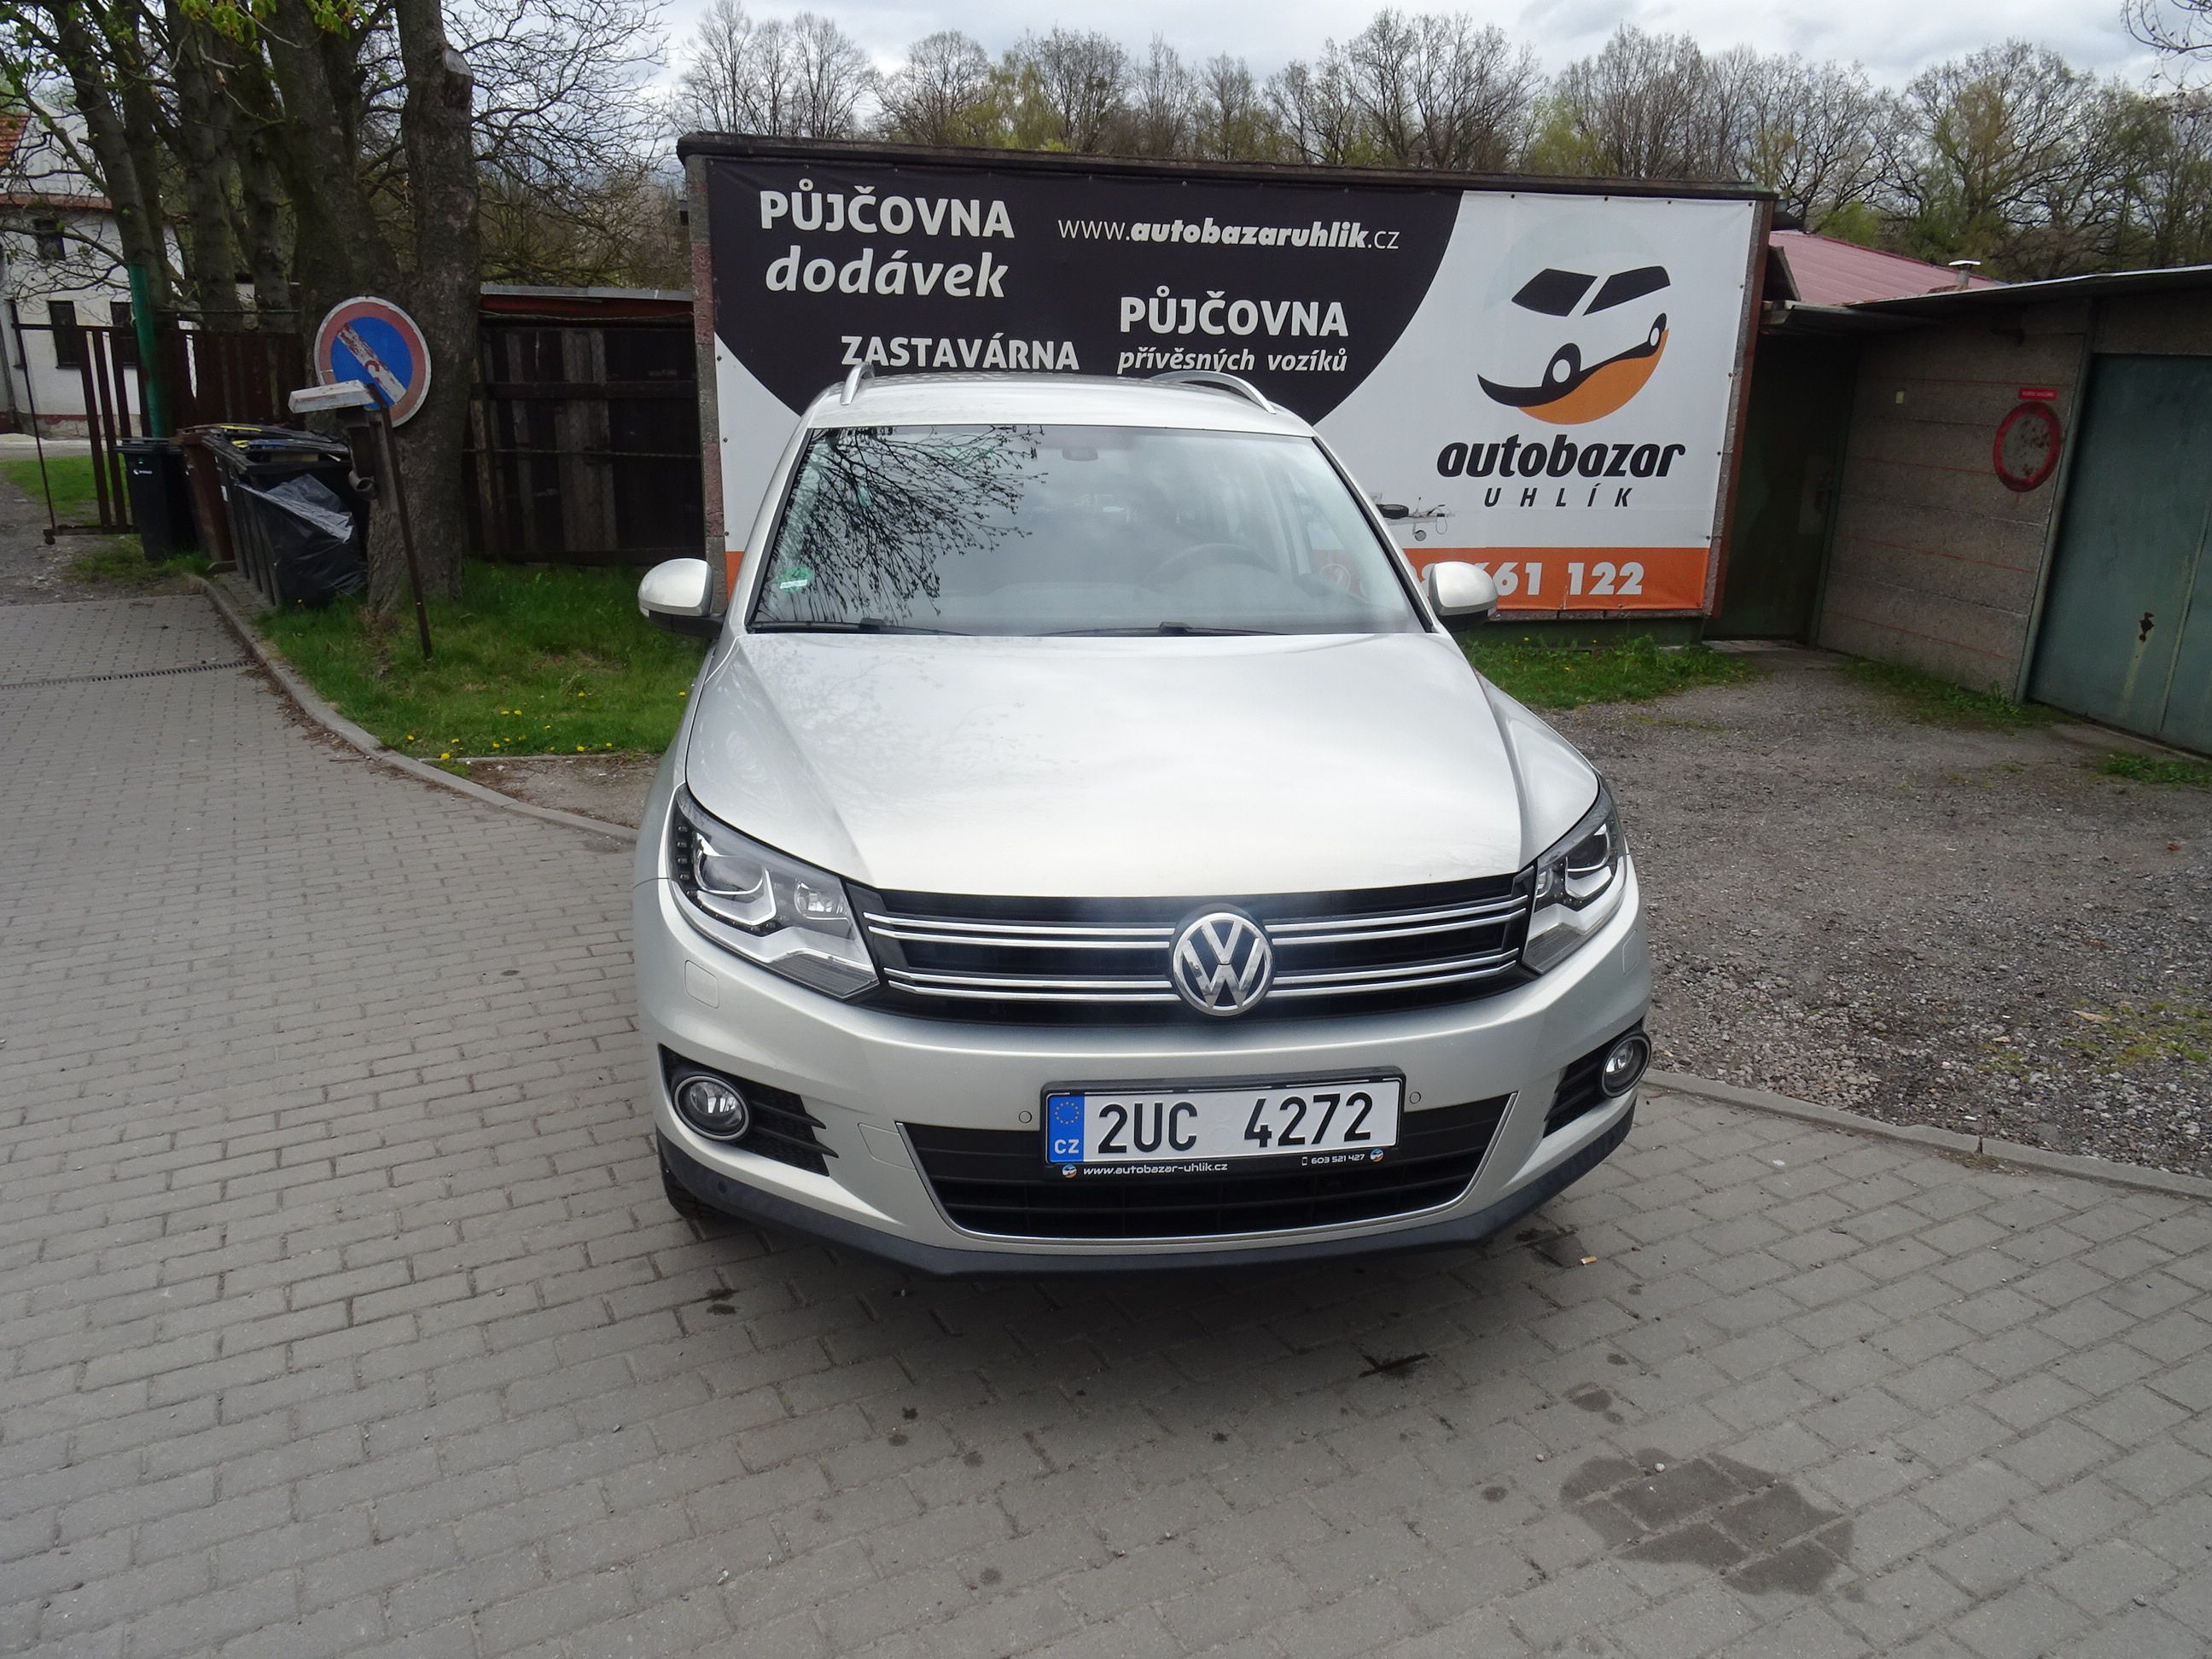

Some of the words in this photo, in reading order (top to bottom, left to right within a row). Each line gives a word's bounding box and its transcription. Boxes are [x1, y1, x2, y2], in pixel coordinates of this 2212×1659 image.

[760, 178, 1015, 238] PŮJČOVNA
[1058, 217, 1400, 249] www.autobazaruhlik.cz
[765, 245, 1009, 297] dodávek
[1120, 285, 1348, 336] PŮJČOVNA
[841, 332, 1080, 370] ZASTAVÁRNA
[1117, 346, 1254, 375] přívěsných
[1267, 348, 1348, 372] vozíků
[1437, 434, 1686, 477] autobazar
[1475, 562, 1543, 597] 61
[1568, 562, 1644, 596] 122
[1097, 1101, 1197, 1154] 2UC
[1244, 1091, 1373, 1148] 4272
[1054, 1138, 1080, 1154] CZ
[1348, 1153, 1365, 1161] 427
[1083, 1162, 1228, 1175] www.autobazar-uhlik.cz
